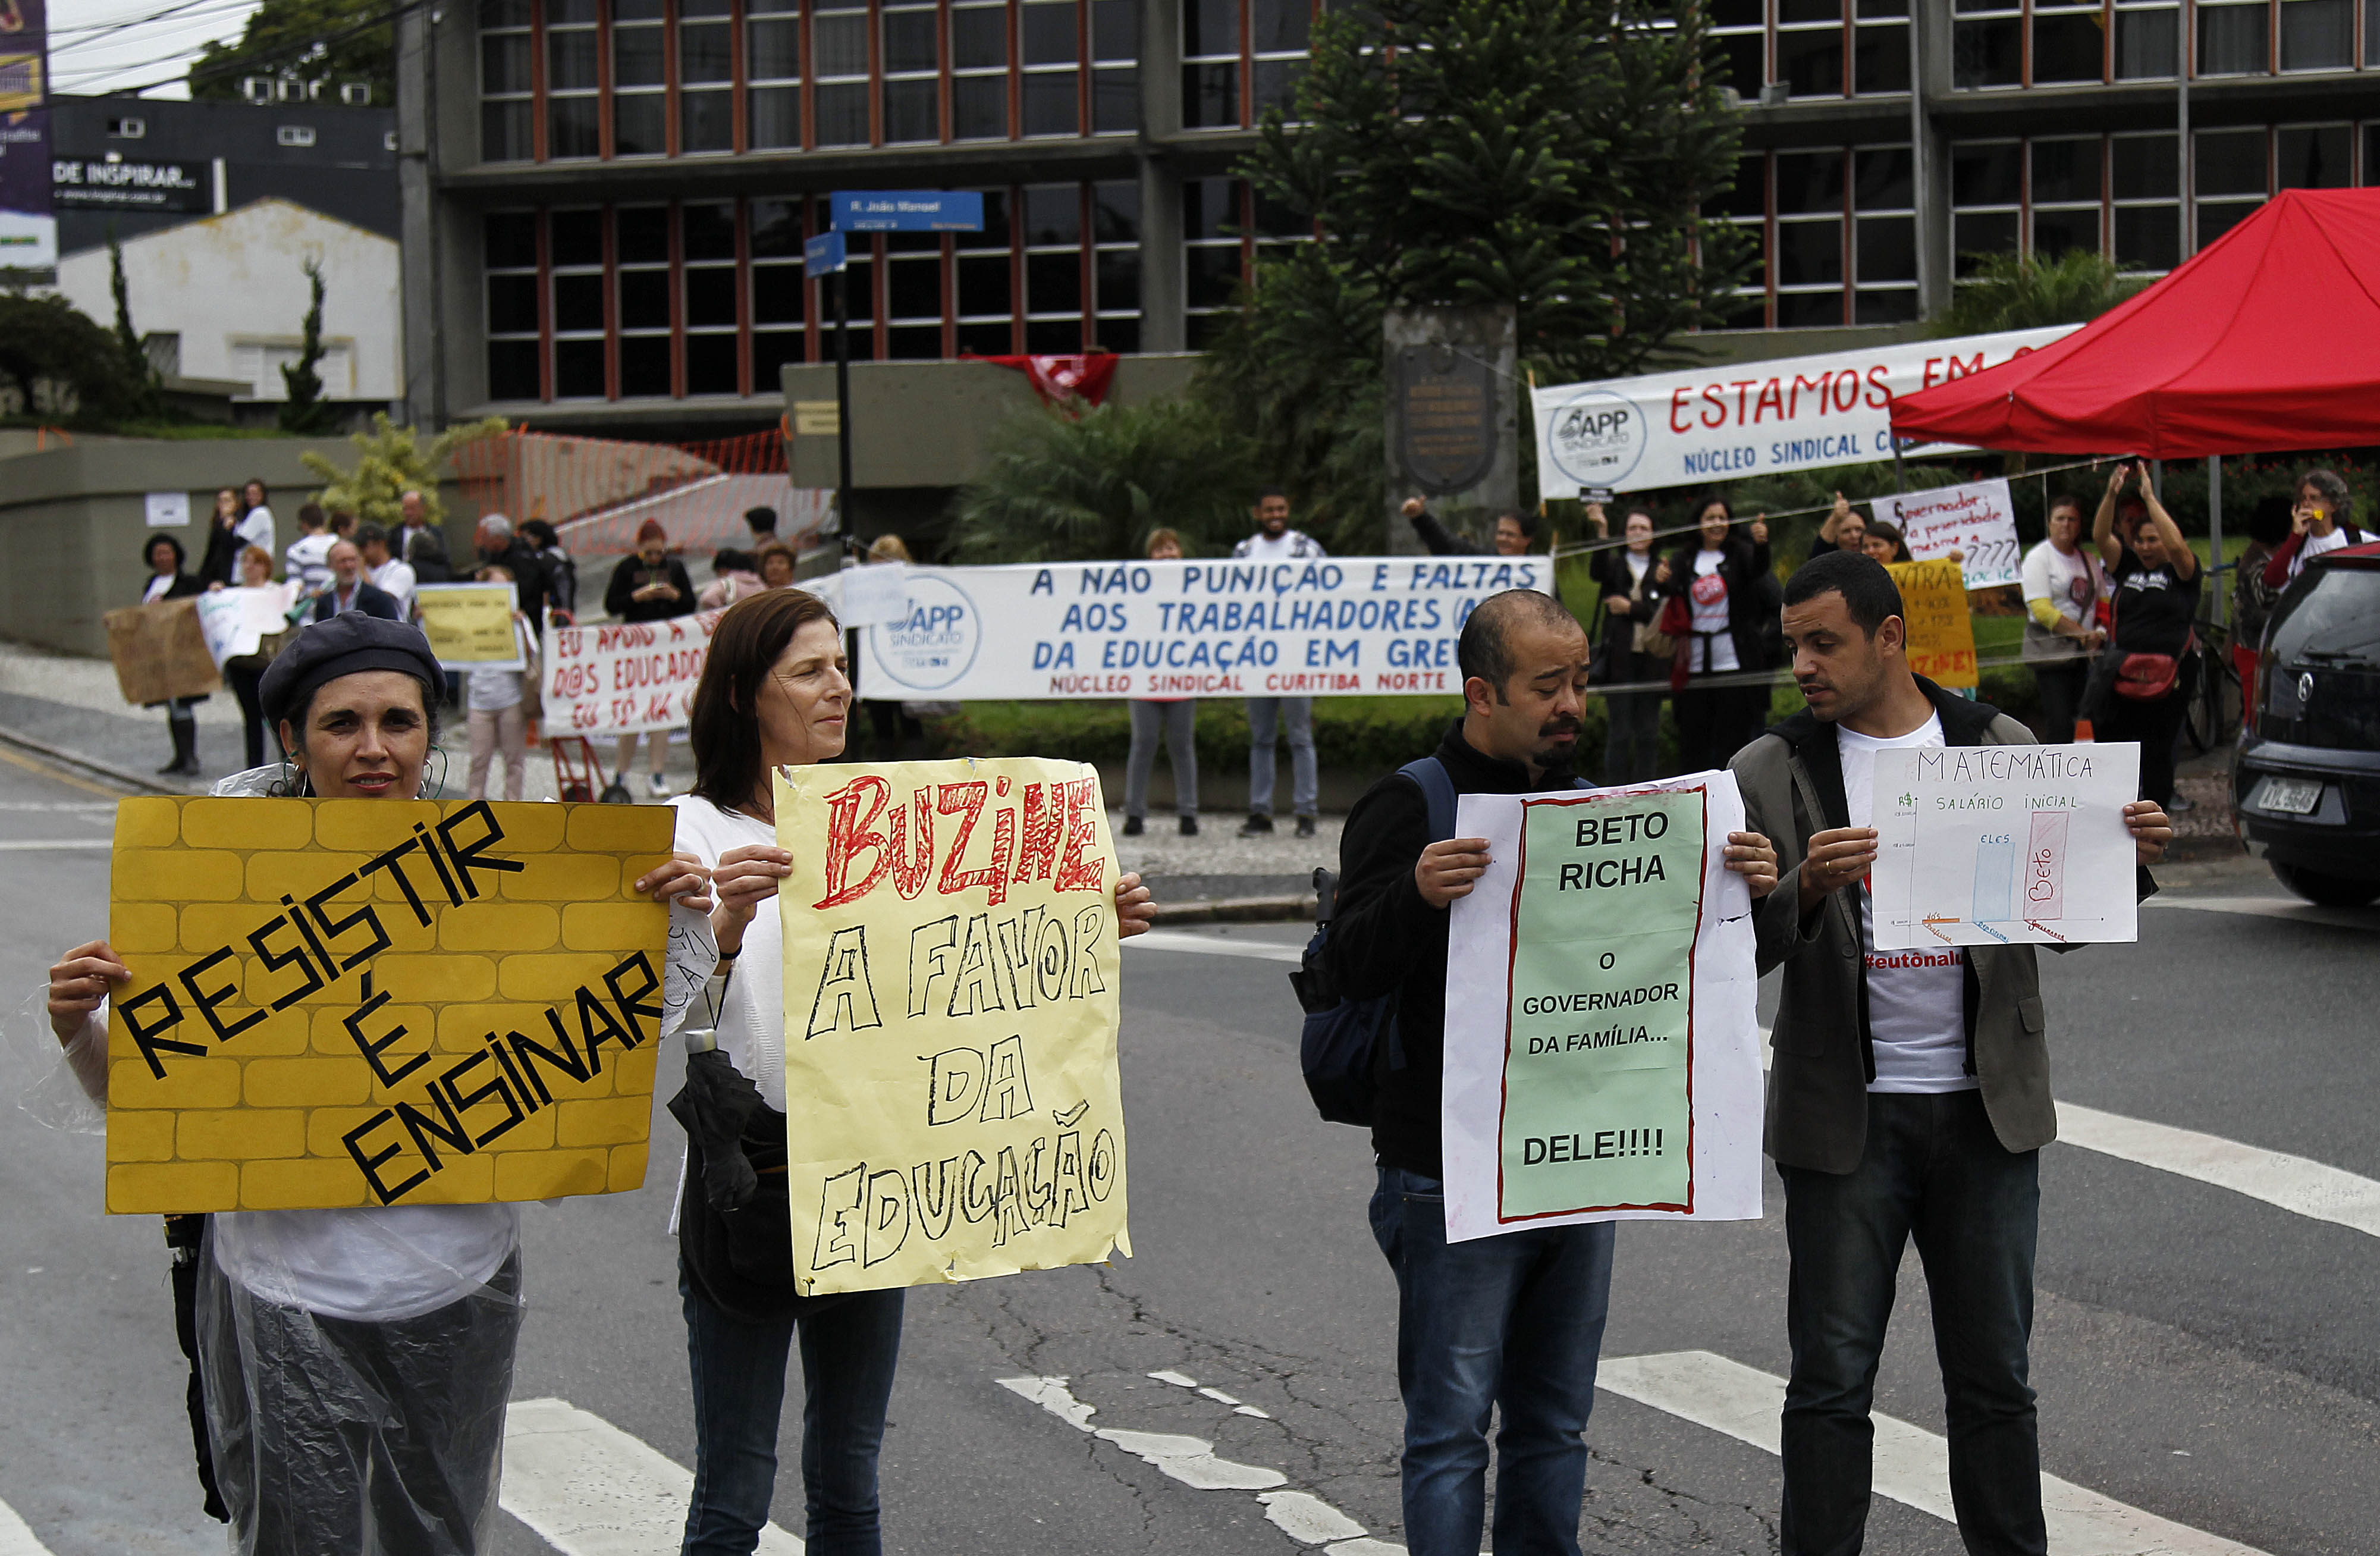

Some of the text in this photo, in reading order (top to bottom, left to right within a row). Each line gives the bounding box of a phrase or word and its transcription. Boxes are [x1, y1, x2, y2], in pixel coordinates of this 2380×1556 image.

[1670, 364, 1894, 434] ESTAMOS
[1580, 409, 1628, 438] APP
[1684, 446, 1756, 475] NÚCLEO
[1771, 434, 1861, 465] SINDICAL
[1032, 561, 1536, 597] A NÃO PUNIÇÃO E FALTAS
[909, 605, 963, 632] APP
[1061, 603, 1127, 633] AOS
[1158, 600, 1440, 633] TRABALHADORES
[614, 647, 710, 690] EDUCADO
[1032, 635, 1459, 673] DA EDUCAÇÃO EM GRE
[1050, 673, 1445, 694] NÚCLEO SINDICAL CURITIBA NORTE
[1918, 748, 2093, 782] MATEMÁTICA
[1936, 792, 2004, 810] SALÁRIO
[2024, 794, 2077, 810] INICIAL
[811, 775, 1106, 910] BUZINE
[1575, 811, 1669, 848] BETO
[1559, 854, 1666, 891] RICHA
[118, 800, 525, 1080] RESISTIR
[805, 925, 883, 1041] A
[908, 904, 1106, 1018] FAVOR
[1599, 952, 1615, 970] O
[1523, 983, 1679, 1015] GOVERNADOR
[343, 971, 432, 1089] É
[1528, 1024, 1669, 1055] DA FAMÍLIA...
[341, 950, 664, 1206] ENSINAR
[917, 1034, 1034, 1126] DA
[1524, 1128, 1663, 1166] DELE!!!!
[811, 1099, 1116, 1271] EDUCAÇÃO
